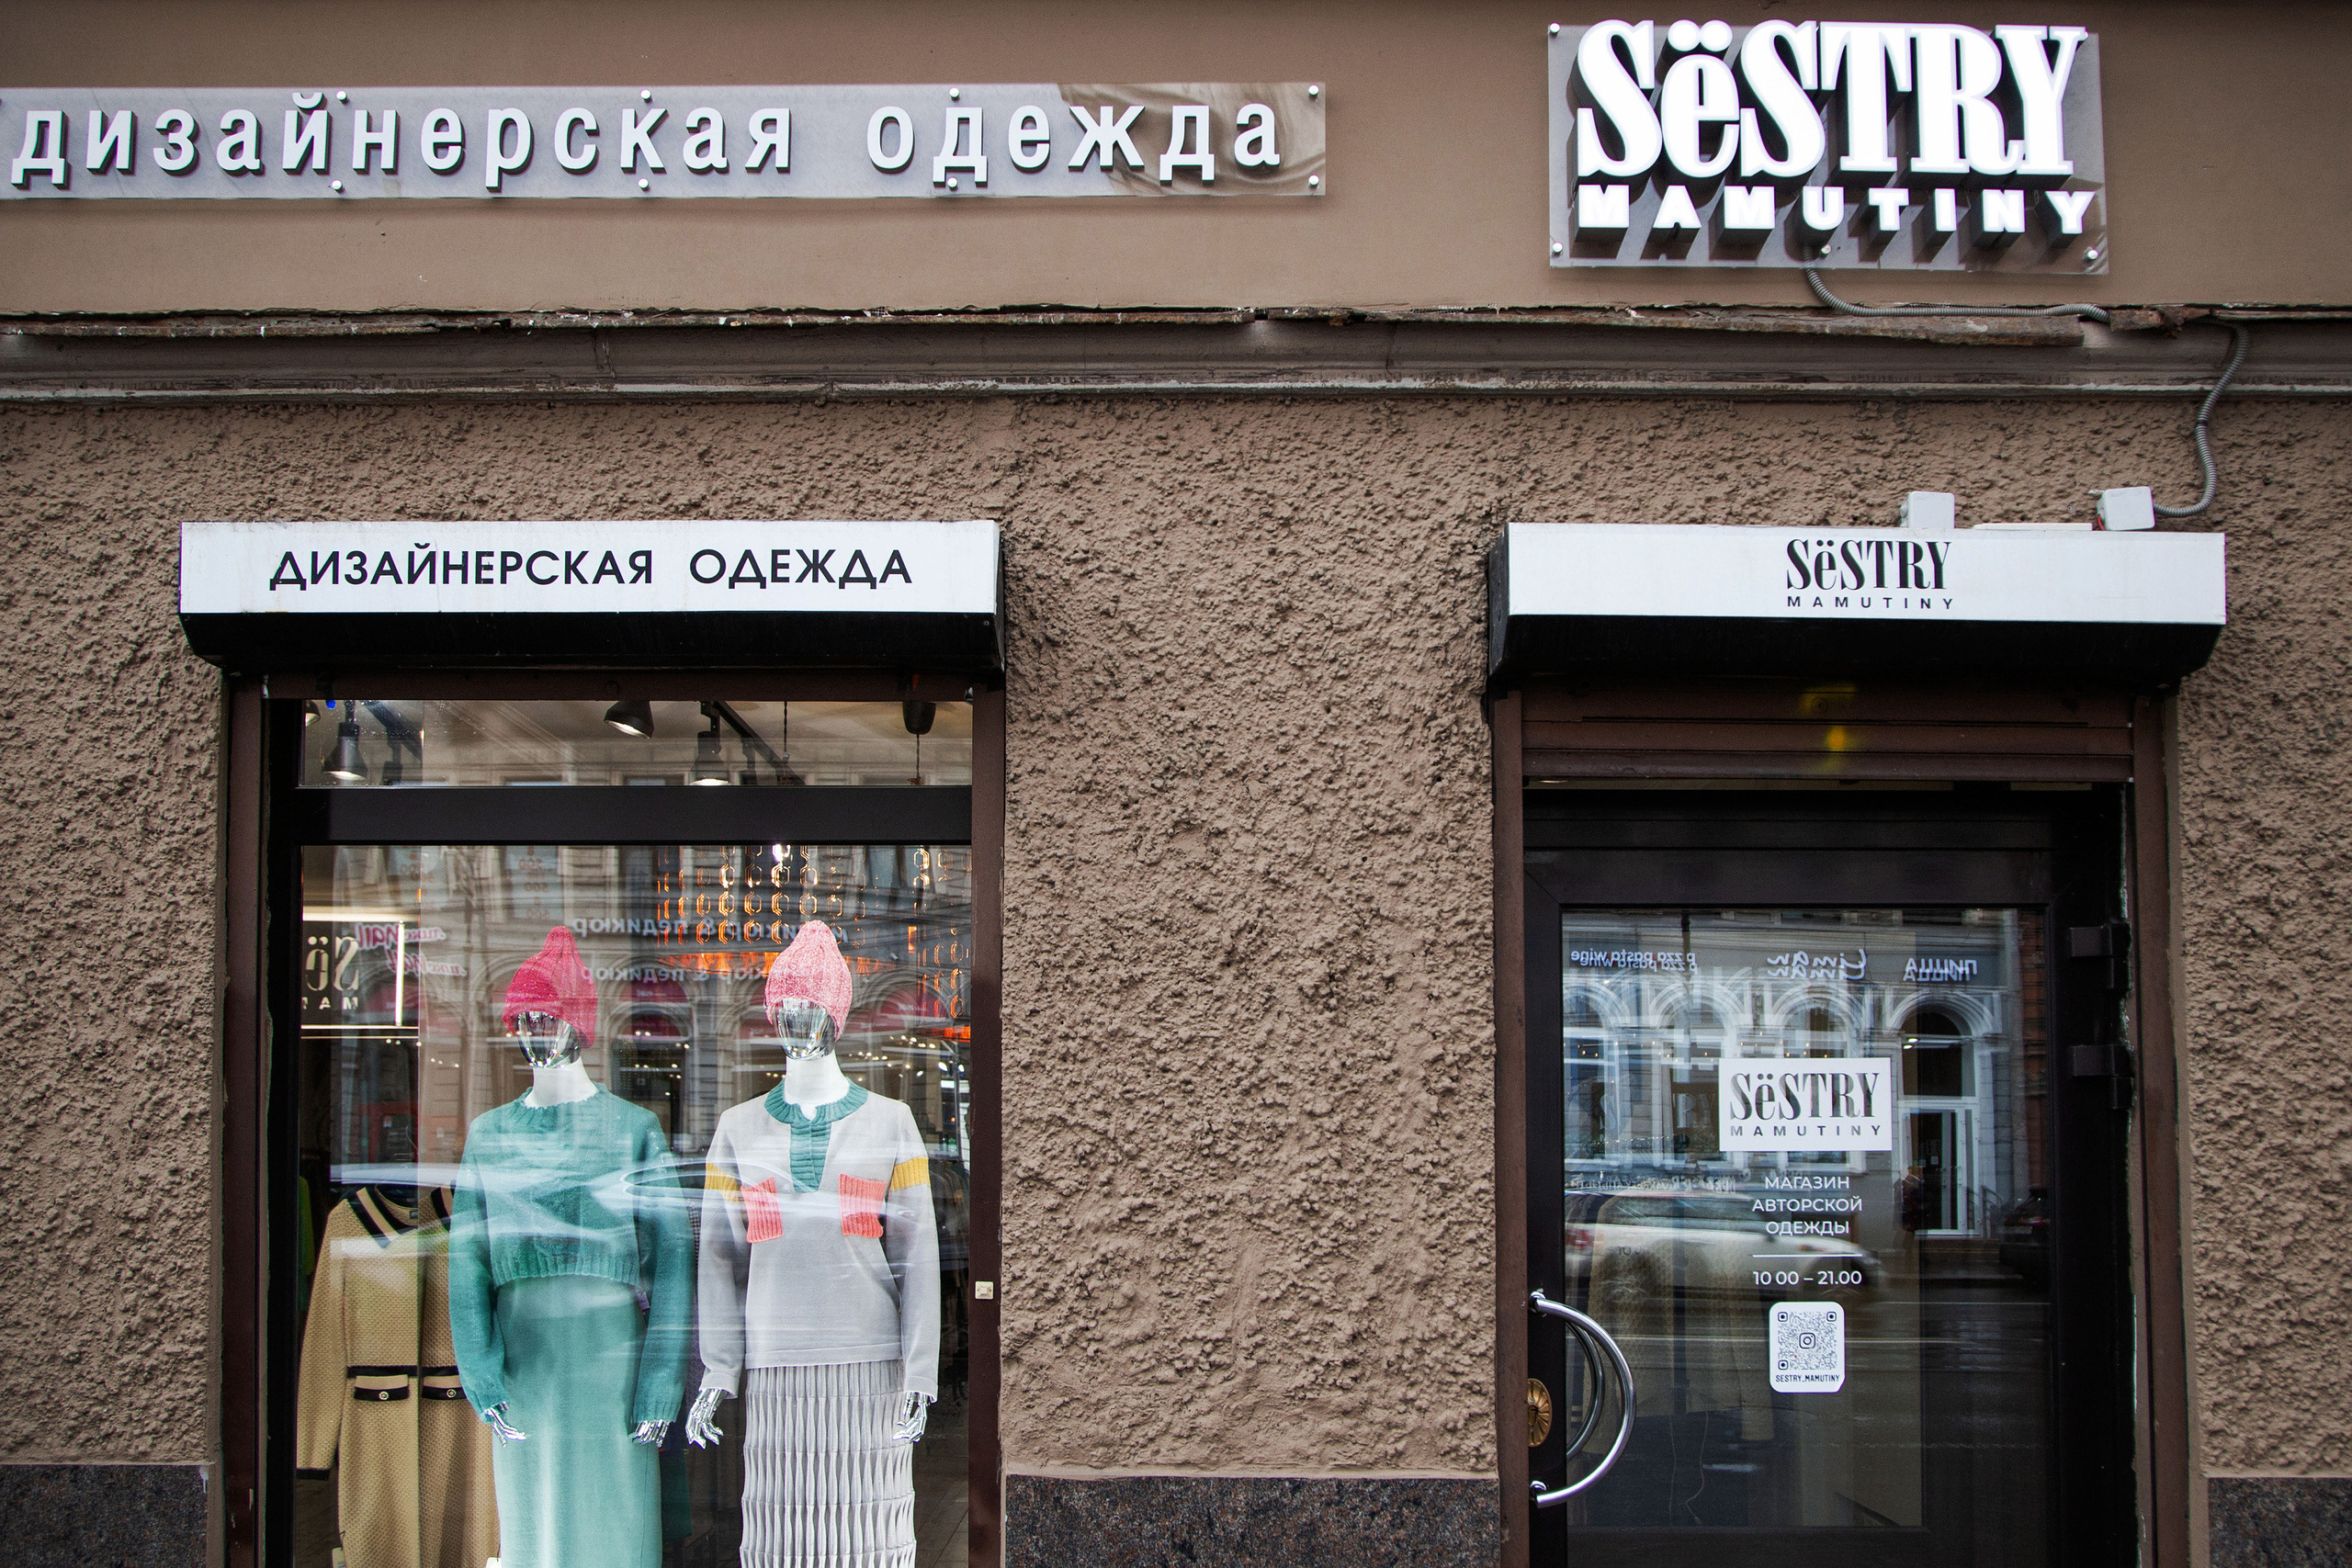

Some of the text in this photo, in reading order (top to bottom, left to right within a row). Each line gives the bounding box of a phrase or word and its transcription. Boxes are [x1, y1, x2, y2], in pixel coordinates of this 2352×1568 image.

[1577, 19, 2088, 177] SëSTRY
[11, 92, 1280, 188] дизайнерская одежда
[1577, 185, 2096, 234] MAMUTINY
[269, 542, 912, 592] ДИЗАЙНЕРСКАЯ ОДЕЖДА
[1786, 538, 1952, 591] SëSTRY
[1786, 595, 1953, 610] MAMUTINY
[1730, 1072, 1880, 1121] SëSTRY
[1731, 1125, 1882, 1136] MAMUTINY
[1765, 1176, 1850, 1190] МАГАЗИН
[1752, 1195, 1862, 1212] АВТОРСКОЙ
[1766, 1221, 1849, 1236] ОДЕЖДЫ
[1817, 1270, 1862, 1285] 21.00
[1775, 1374, 1840, 1383] SESTRY_MAMUTINY
